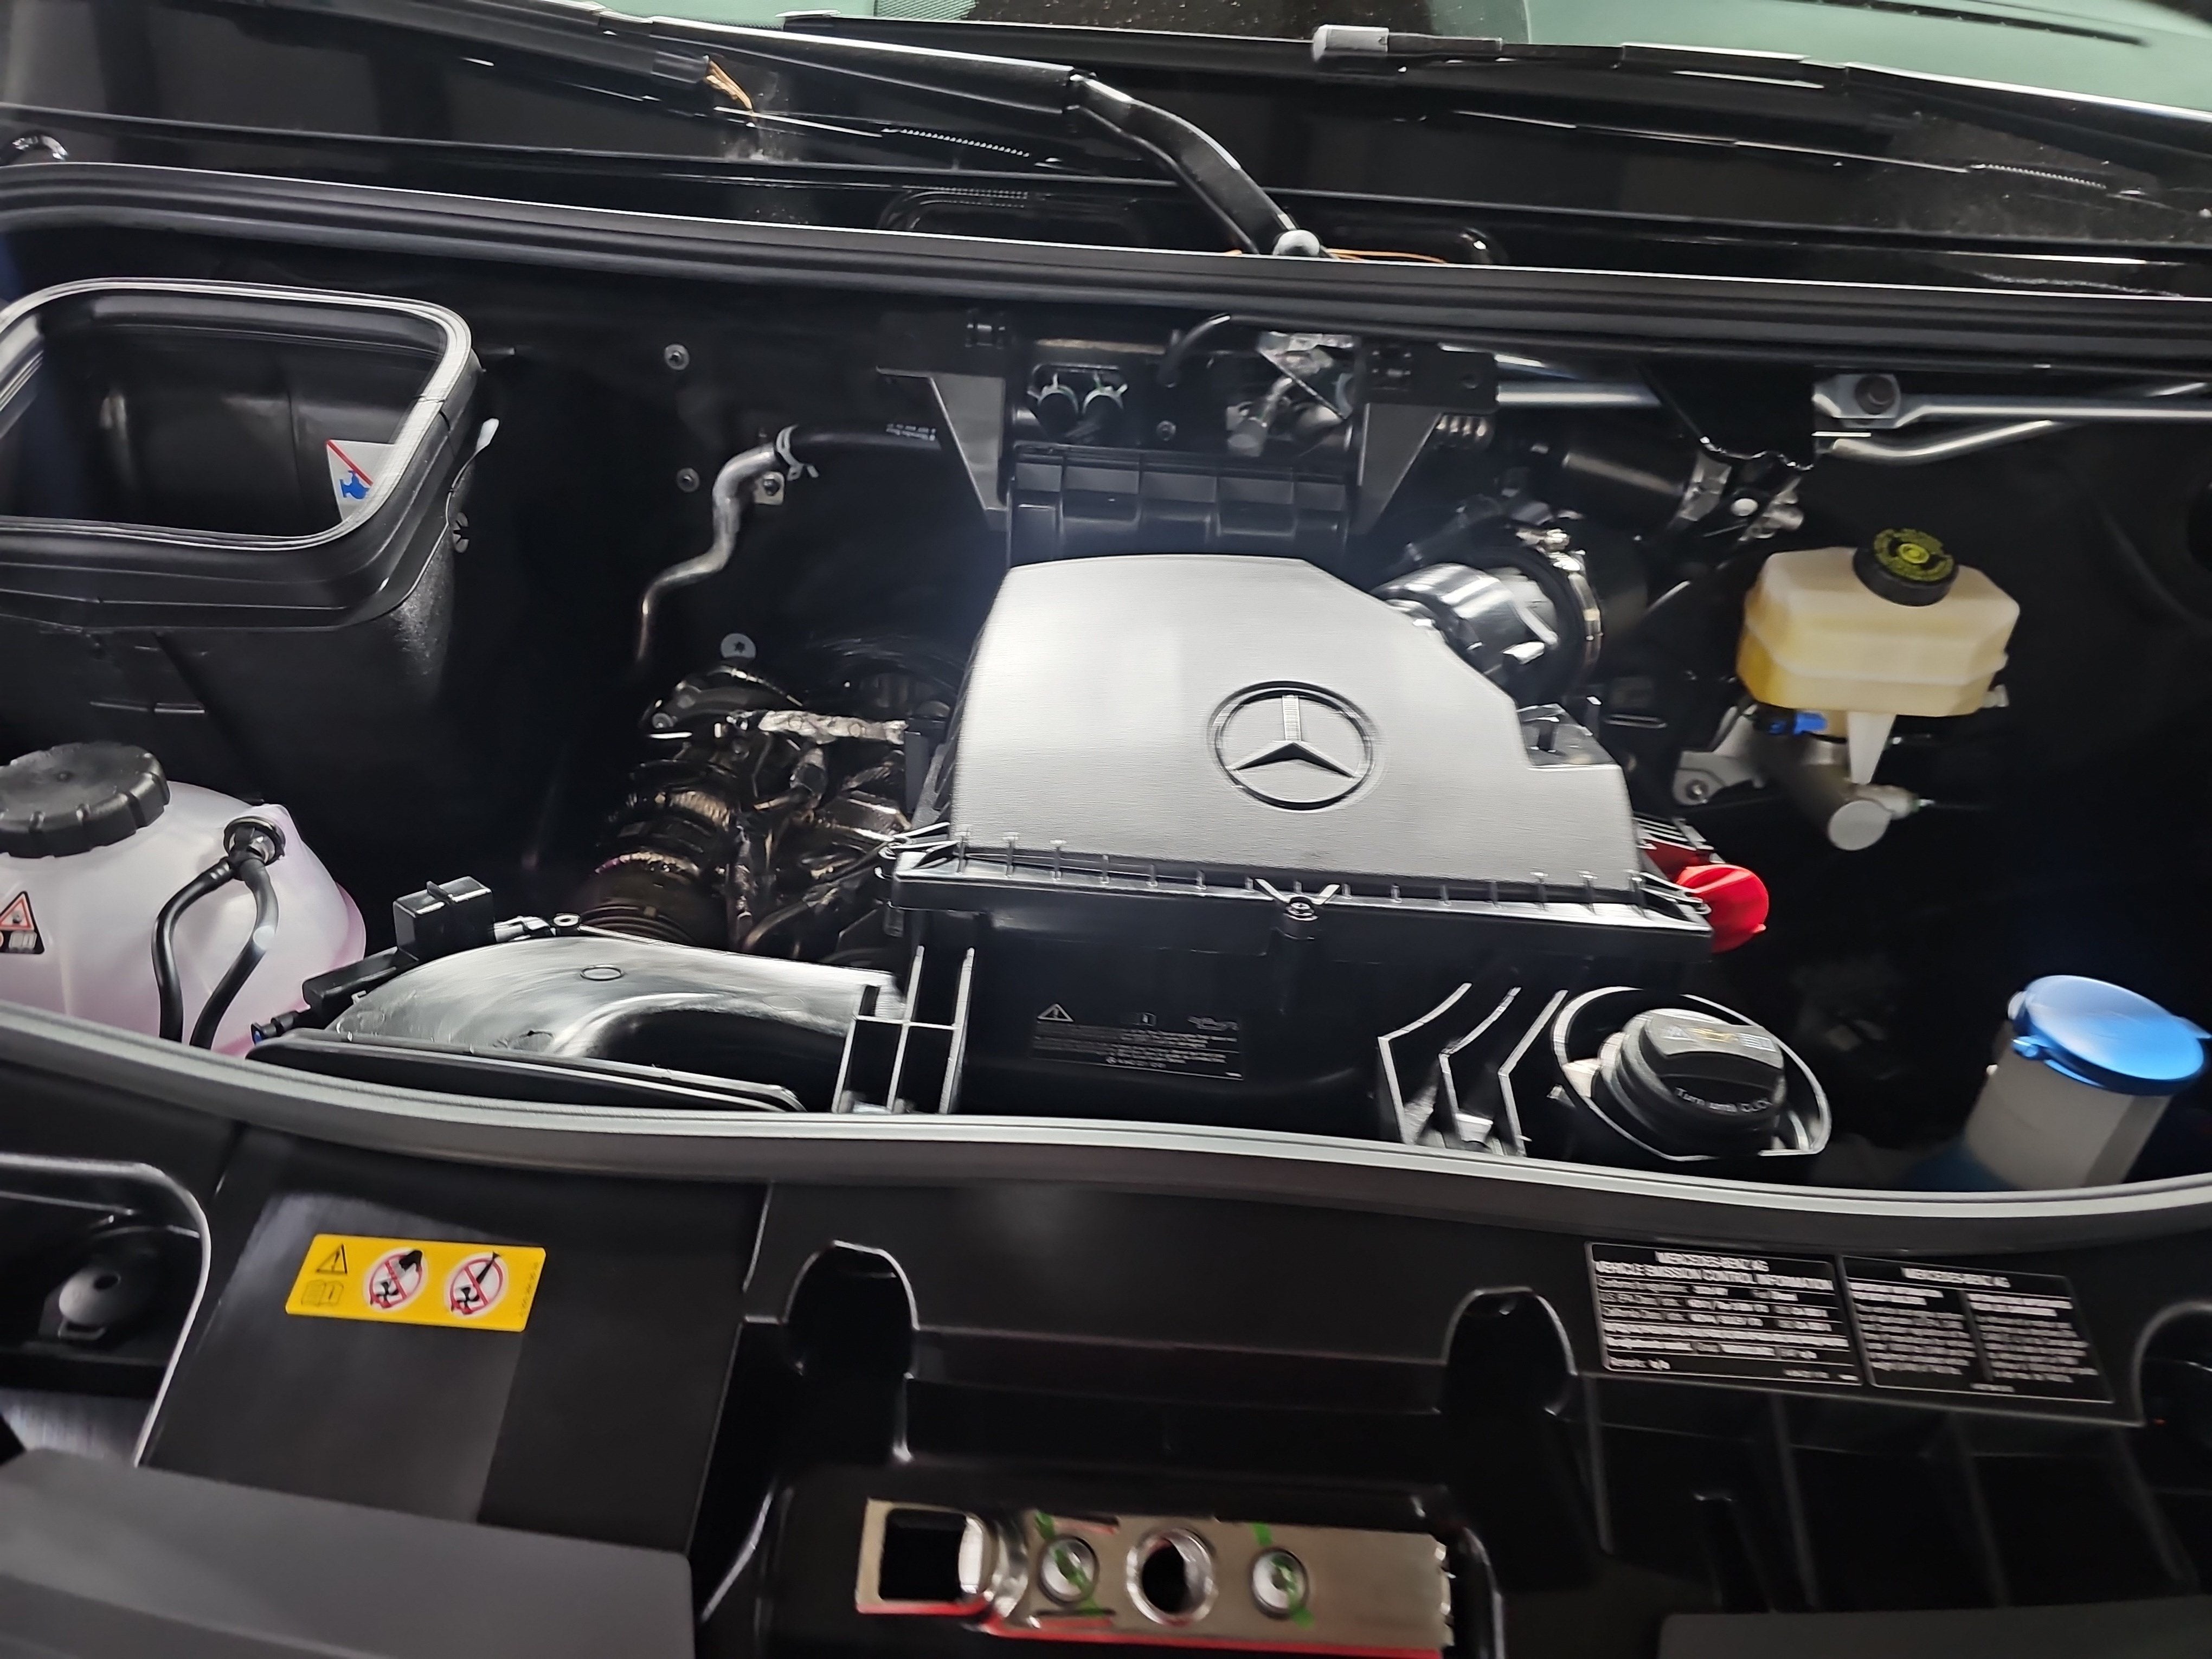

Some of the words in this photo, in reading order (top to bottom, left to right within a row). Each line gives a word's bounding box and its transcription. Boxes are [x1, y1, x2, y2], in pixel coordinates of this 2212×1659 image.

[1596, 1261, 1645, 1276] VEHICLE
[1644, 1264, 1702, 1279] EMISSION
[1702, 1268, 1756, 1284] CONTROL
[1756, 1274, 1834, 1291] INFORMATION
